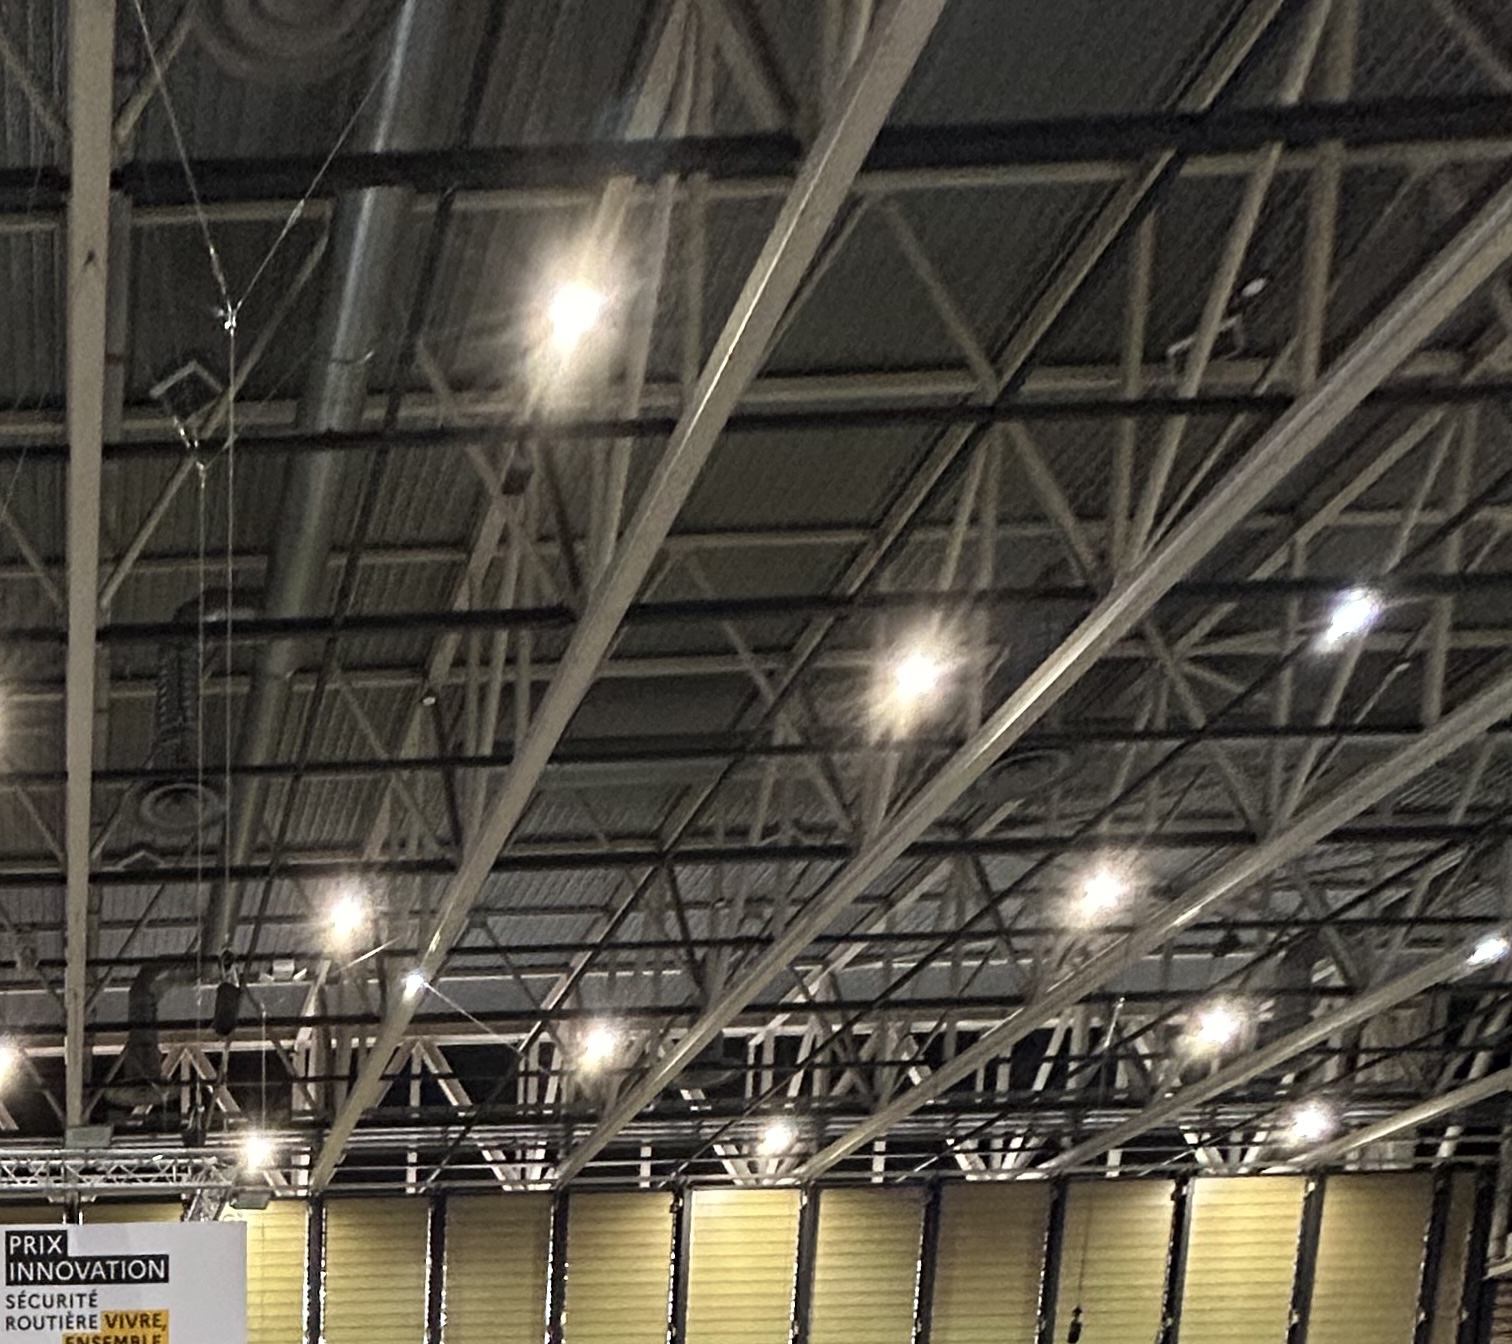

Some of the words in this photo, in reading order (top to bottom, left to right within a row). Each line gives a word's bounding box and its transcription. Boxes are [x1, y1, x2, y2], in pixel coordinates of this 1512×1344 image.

[9, 1234, 63, 1255] PRIX
[9, 1259, 166, 1282] INNOVATION
[5, 1289, 99, 1310] SÉCURITÉ
[5, 1311, 98, 1332] ROUTIÈRE
[104, 1313, 167, 1331] VIVRE,
